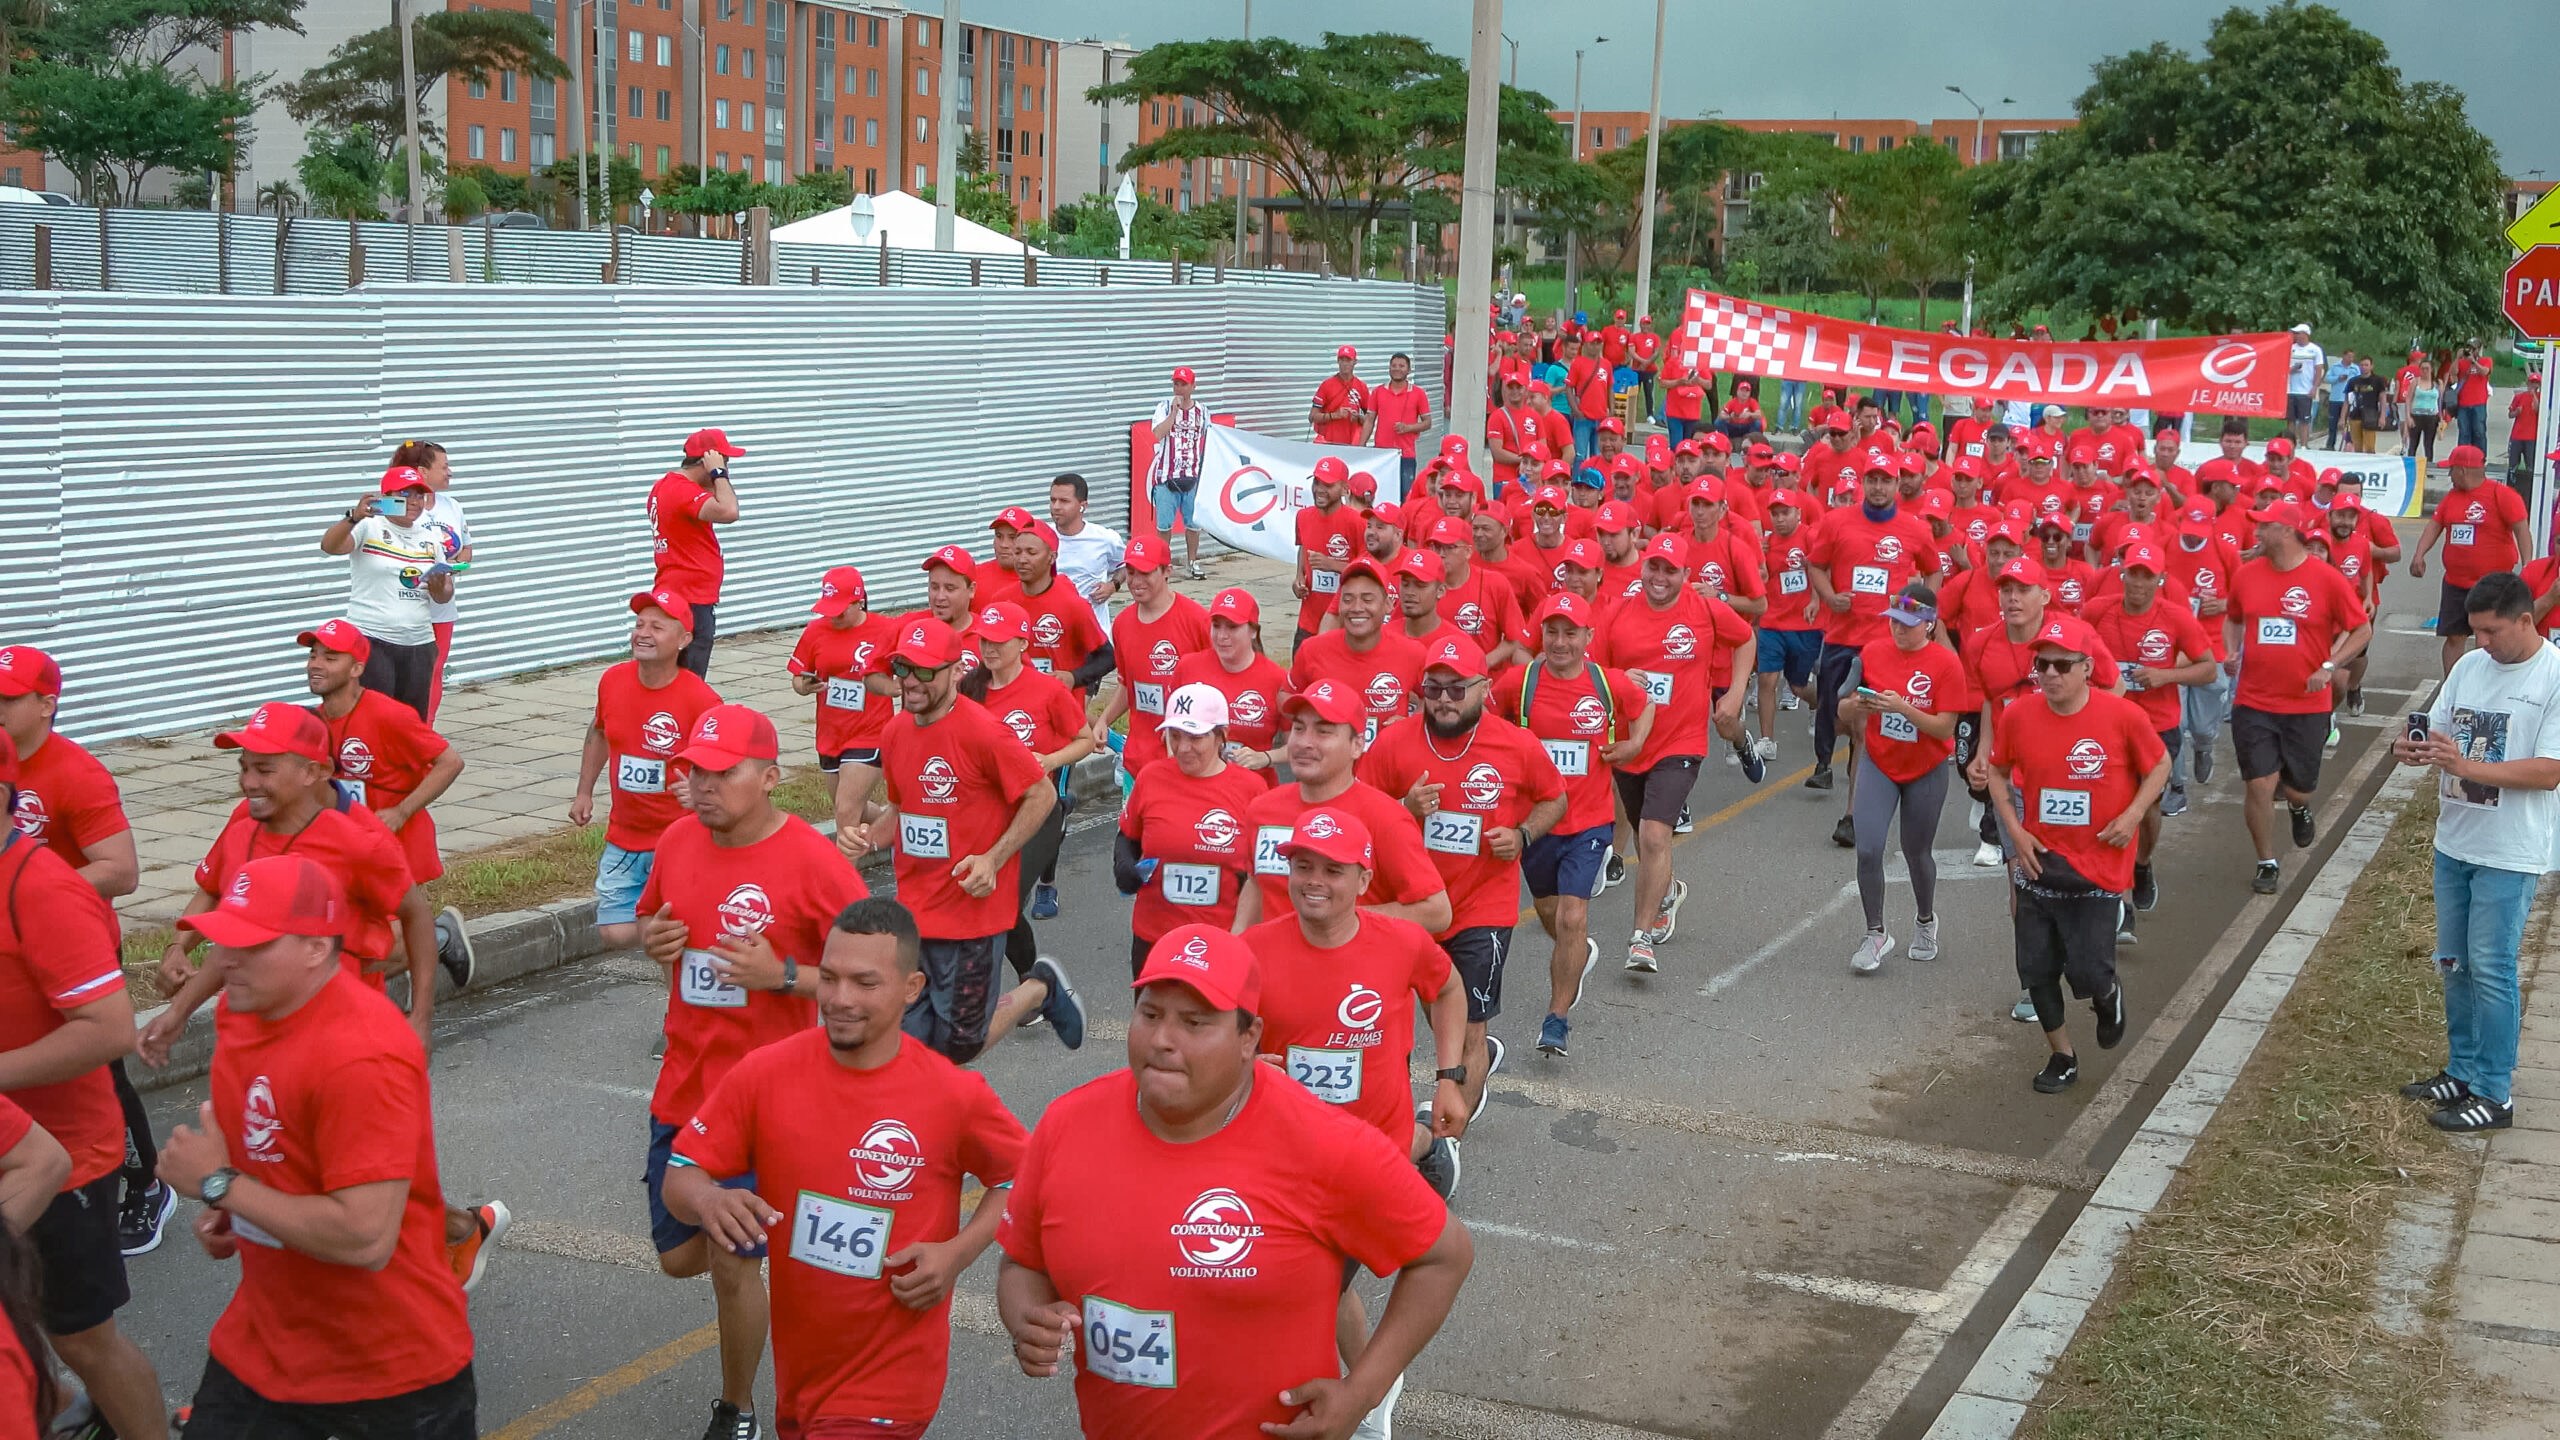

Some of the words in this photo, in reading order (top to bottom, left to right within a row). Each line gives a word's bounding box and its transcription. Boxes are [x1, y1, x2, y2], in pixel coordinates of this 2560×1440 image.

[2517, 278, 2560, 306] PA
[1800, 325, 2151, 397] LLEGADA
[2212, 390, 2265, 407] JAIMES
[1317, 575, 1335, 587] 131
[1856, 573, 1885, 587] 224
[2262, 624, 2294, 639] 023
[832, 686, 858, 703] 212
[1646, 681, 1666, 697] 26
[1138, 690, 1158, 707] 114
[1885, 715, 1914, 734] 226
[1552, 749, 1576, 766] 111
[2046, 798, 2085, 817] 225
[906, 827, 943, 847] 052
[1430, 821, 1474, 844] 222
[1175, 873, 1208, 895] 112
[1345, 1030, 1384, 1047] JAIMES
[1296, 1064, 1353, 1089] 223
[848, 1186, 914, 1201] VOLUNTARIO
[806, 1213, 876, 1258] 146
[1170, 1222, 1240, 1237] CONEXIÓN
[1169, 1265, 1258, 1279] VOLUNTARIO
[1091, 1321, 1169, 1365] 054
